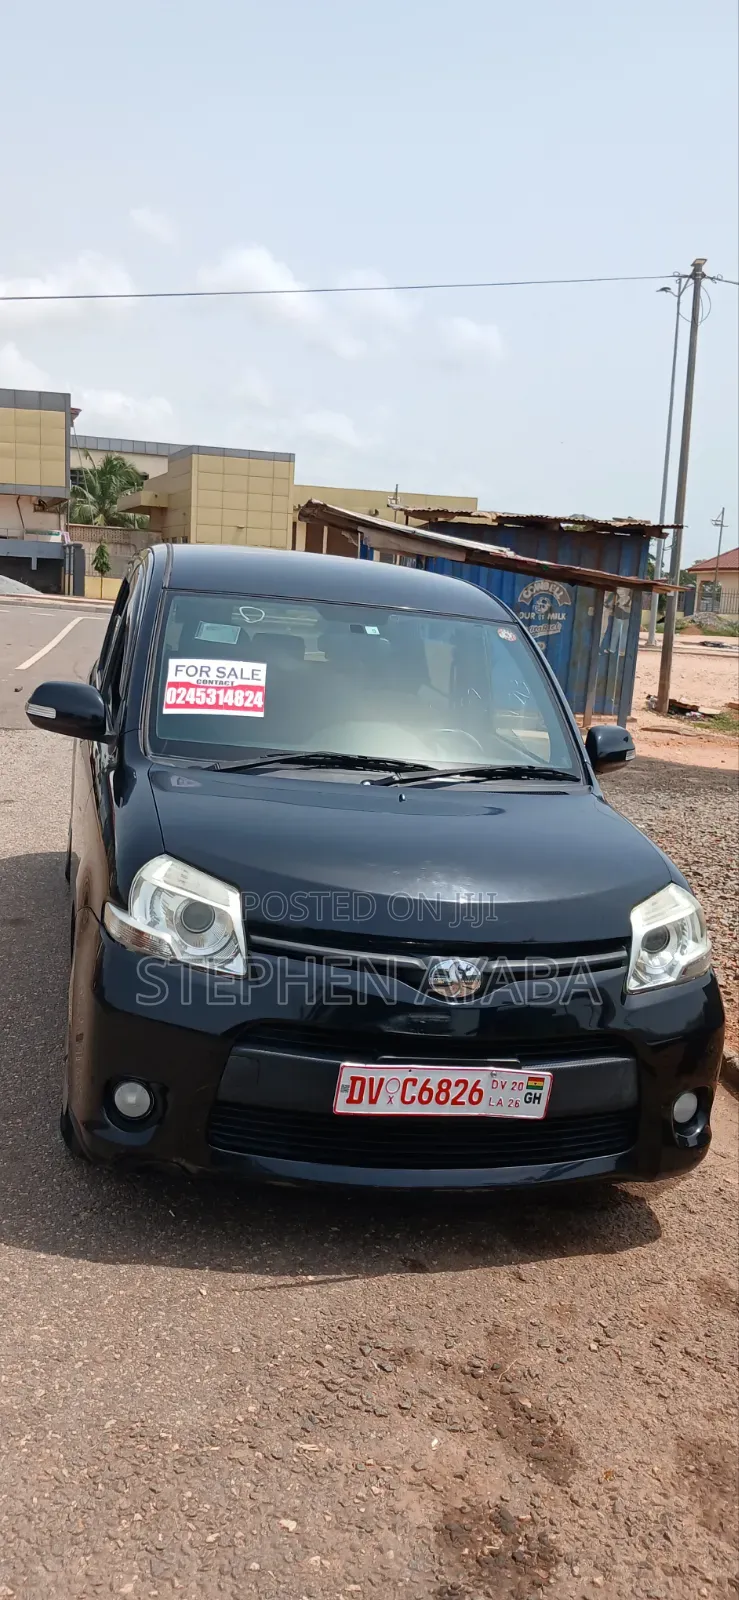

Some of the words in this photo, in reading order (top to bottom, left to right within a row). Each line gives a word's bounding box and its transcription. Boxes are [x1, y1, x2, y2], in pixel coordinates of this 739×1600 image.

[547, 612, 566, 620] MILK
[174, 664, 211, 678] FOR
[216, 666, 262, 681] SALE
[196, 679, 235, 687] CONTACT
[165, 687, 263, 708] 0245314824
[346, 1076, 385, 1105] DV
[400, 1077, 484, 1106] C6826
[491, 1080, 507, 1090] DV
[511, 1081, 524, 1091] 20
[488, 1096, 503, 1107] LA
[508, 1098, 521, 1108] 26
[524, 1092, 542, 1105] GH
